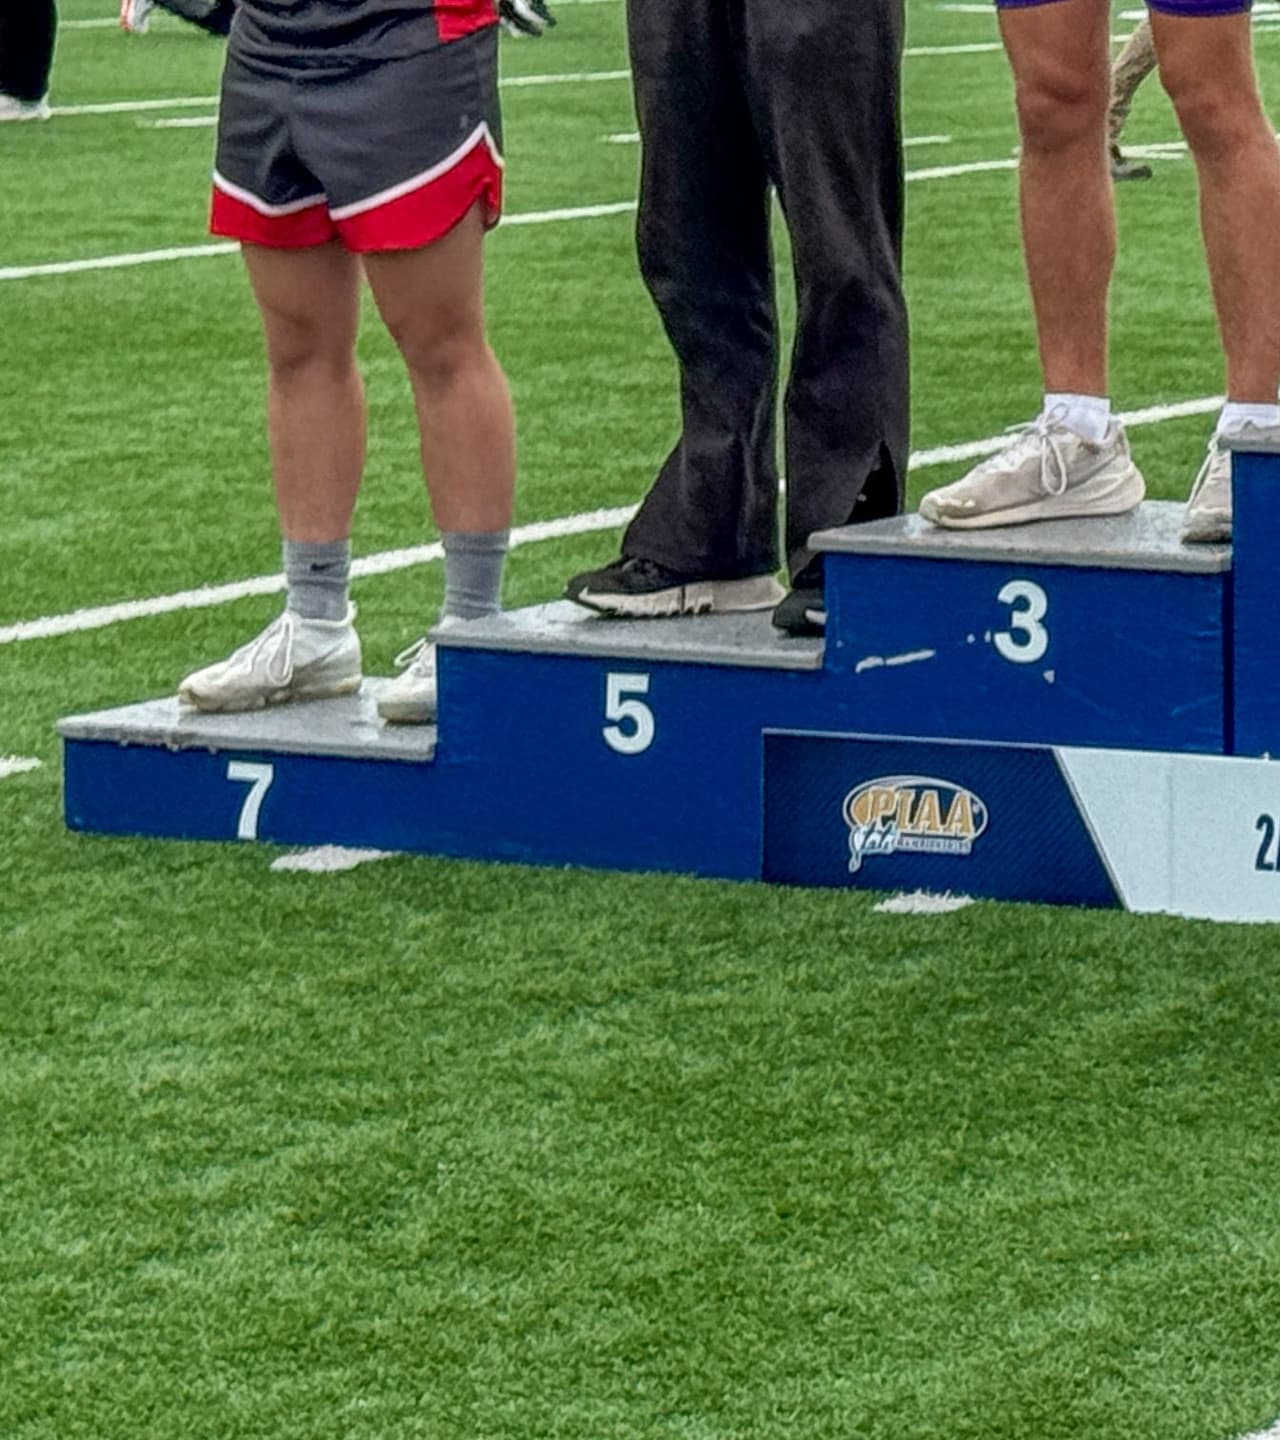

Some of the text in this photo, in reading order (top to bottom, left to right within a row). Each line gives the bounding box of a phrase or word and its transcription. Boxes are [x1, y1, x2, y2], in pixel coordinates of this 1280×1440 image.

[994, 580, 1049, 663] 3
[603, 672, 655, 754] 5
[227, 762, 273, 840] 7
[866, 786, 974, 835] PIAA
